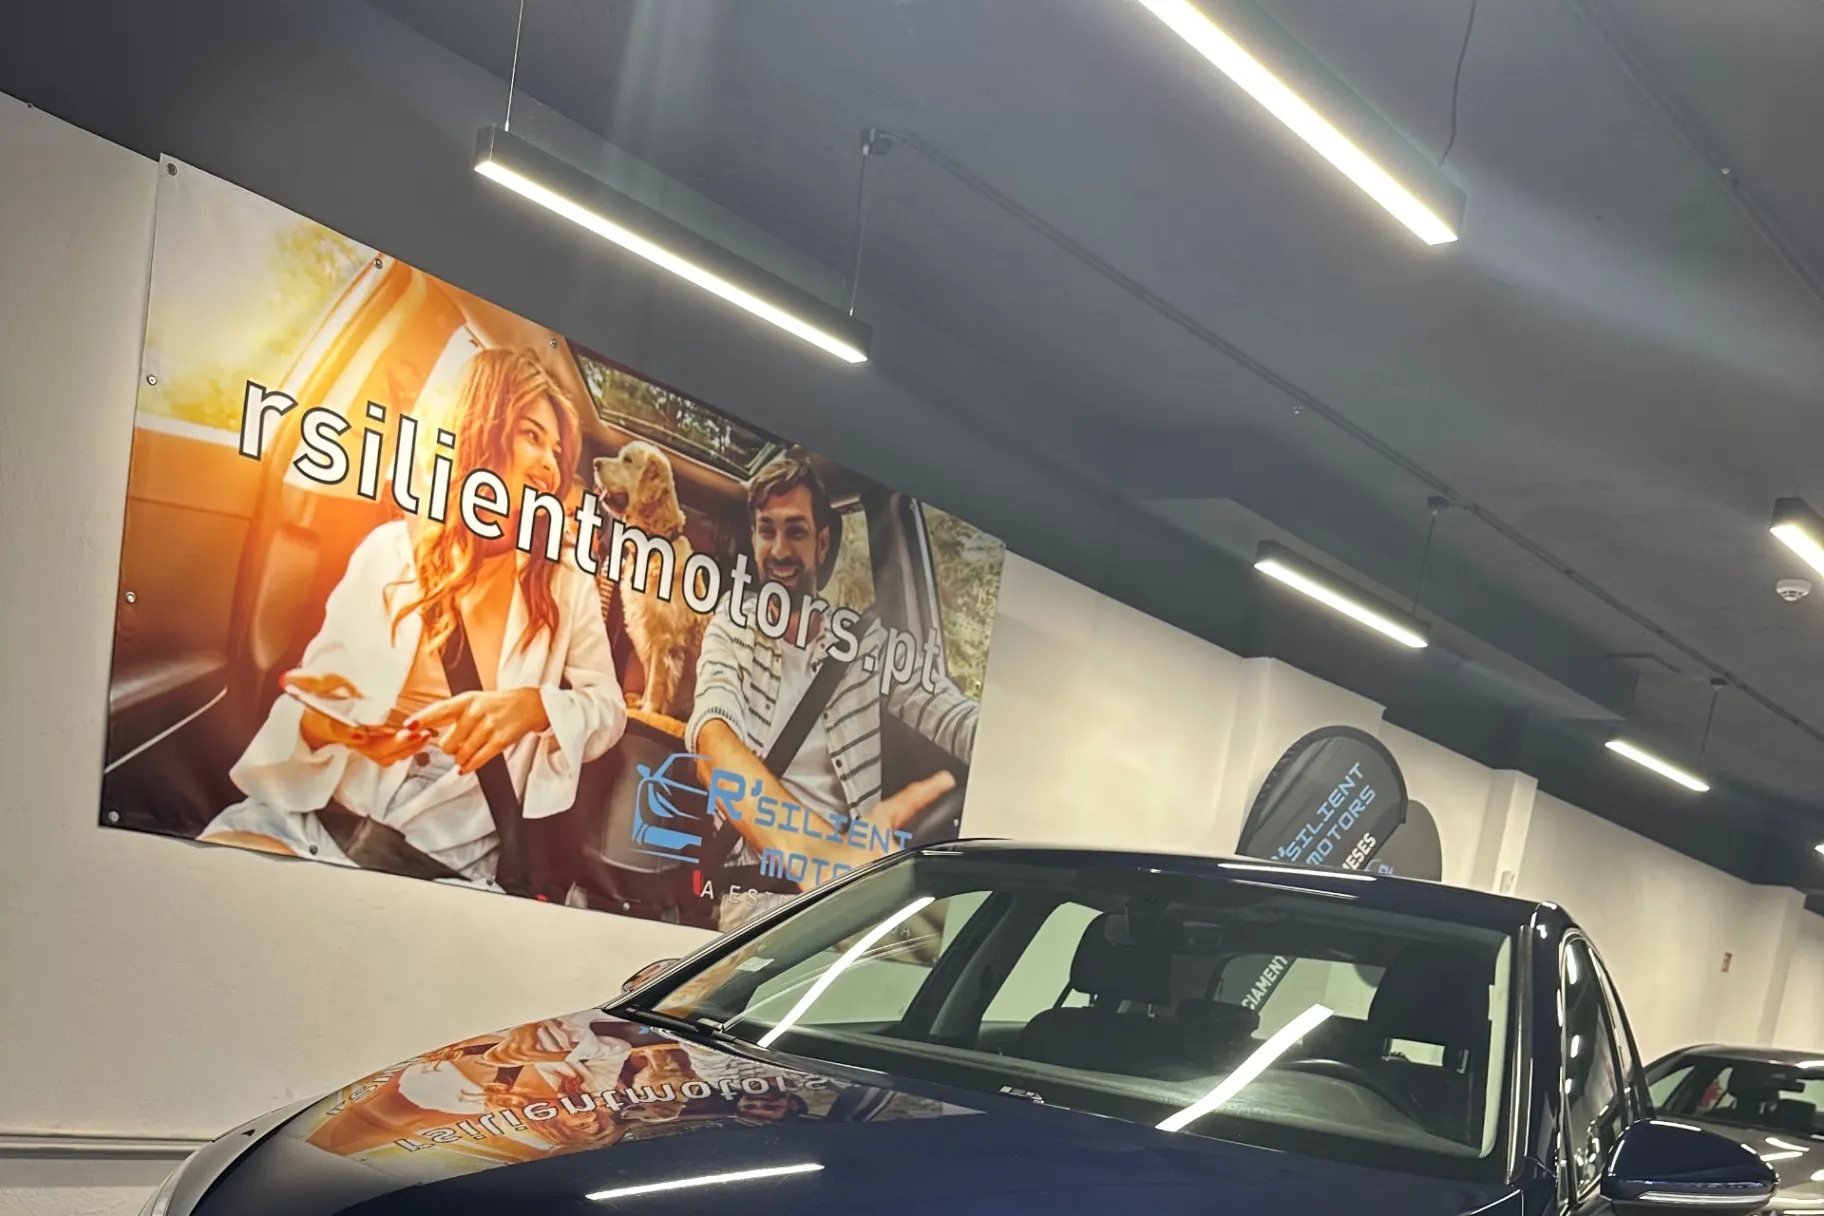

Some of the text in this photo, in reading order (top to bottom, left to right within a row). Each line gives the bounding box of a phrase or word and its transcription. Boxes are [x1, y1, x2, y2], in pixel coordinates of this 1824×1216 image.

[238, 381, 940, 696] rsilientmotors.pt
[706, 767, 913, 853] R'SILIENT
[1306, 785, 1376, 865] MOTORS
[700, 880, 714, 900] A
